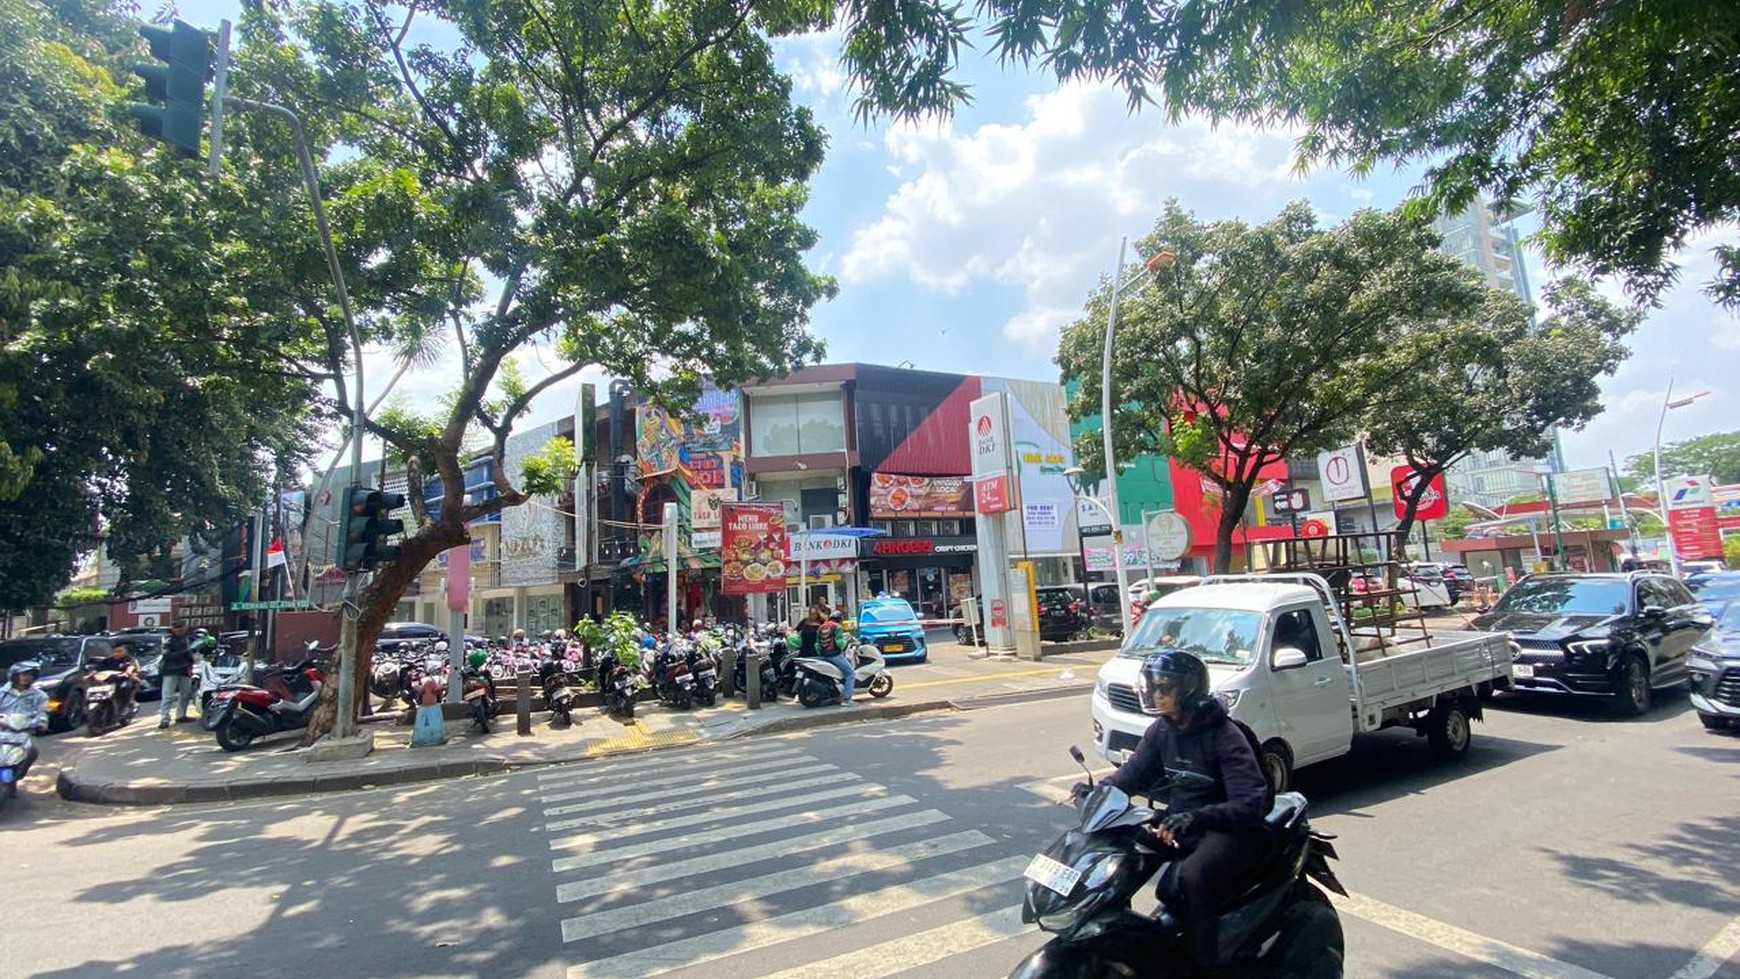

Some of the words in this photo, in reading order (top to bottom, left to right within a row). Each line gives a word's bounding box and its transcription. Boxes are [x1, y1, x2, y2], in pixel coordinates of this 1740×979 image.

[979, 444, 996, 455] DKI
[981, 480, 998, 491] ATM
[833, 539, 852, 548] DKI
